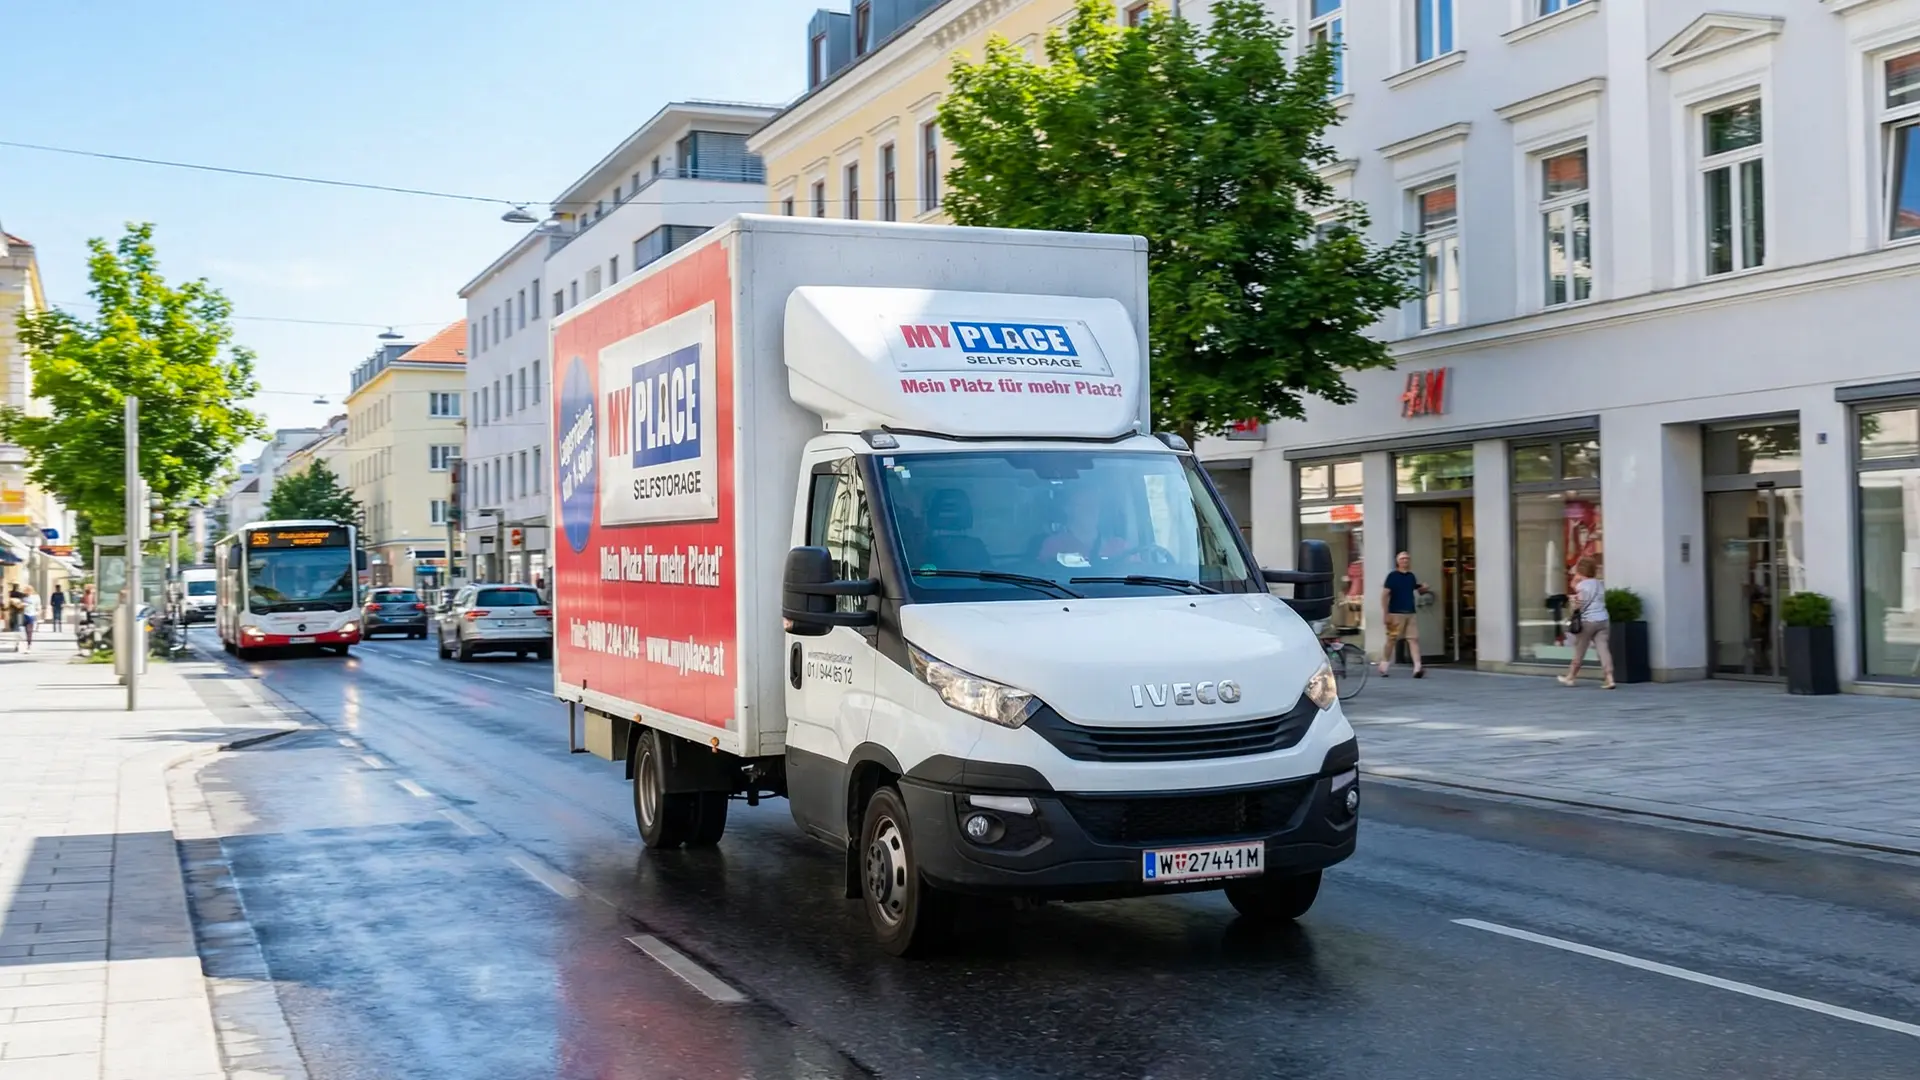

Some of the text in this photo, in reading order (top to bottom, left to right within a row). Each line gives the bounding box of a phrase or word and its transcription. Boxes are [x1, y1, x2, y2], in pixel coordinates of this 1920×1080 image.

[900, 325, 1069, 352] MY PLACE
[966, 355, 1082, 368] SELFSTORAGE
[901, 378, 1122, 398] Mein Platz für mehr Platz?
[608, 363, 697, 457] MY PLACE
[633, 470, 702, 500] SELFSTORAGE
[660, 545, 685, 584] mehr
[1131, 680, 1241, 708] IVECO
[1160, 855, 1173, 874] W
